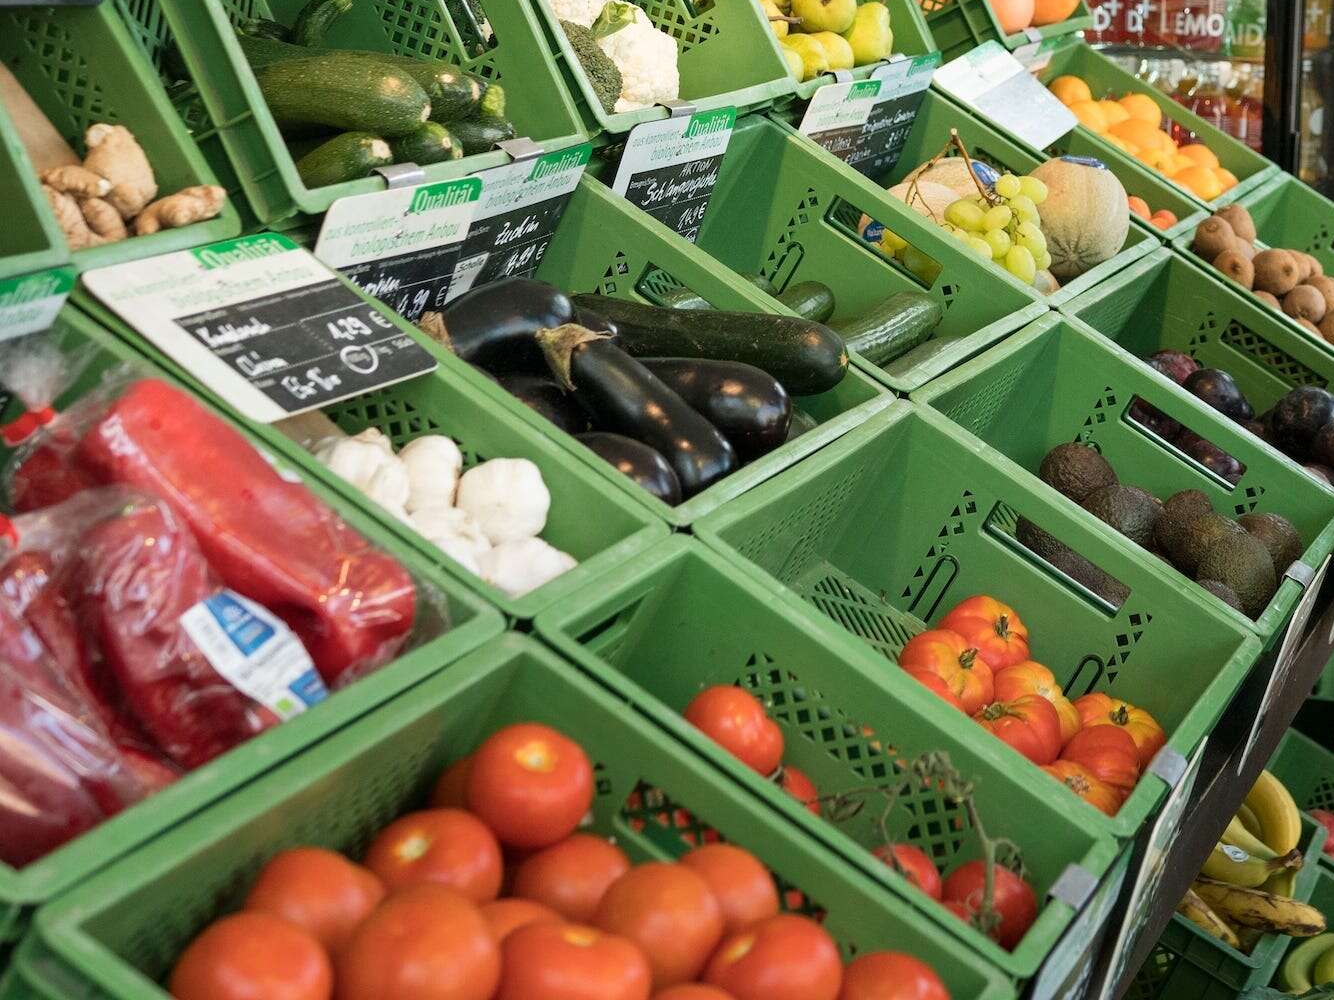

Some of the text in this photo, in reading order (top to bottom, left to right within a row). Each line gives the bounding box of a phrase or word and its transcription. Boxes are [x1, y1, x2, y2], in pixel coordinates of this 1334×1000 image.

[689, 114, 729, 140] Qualität
[533, 152, 583, 181] Qualität
[415, 184, 474, 215] Qualität
[200, 238, 285, 268] Qualität
